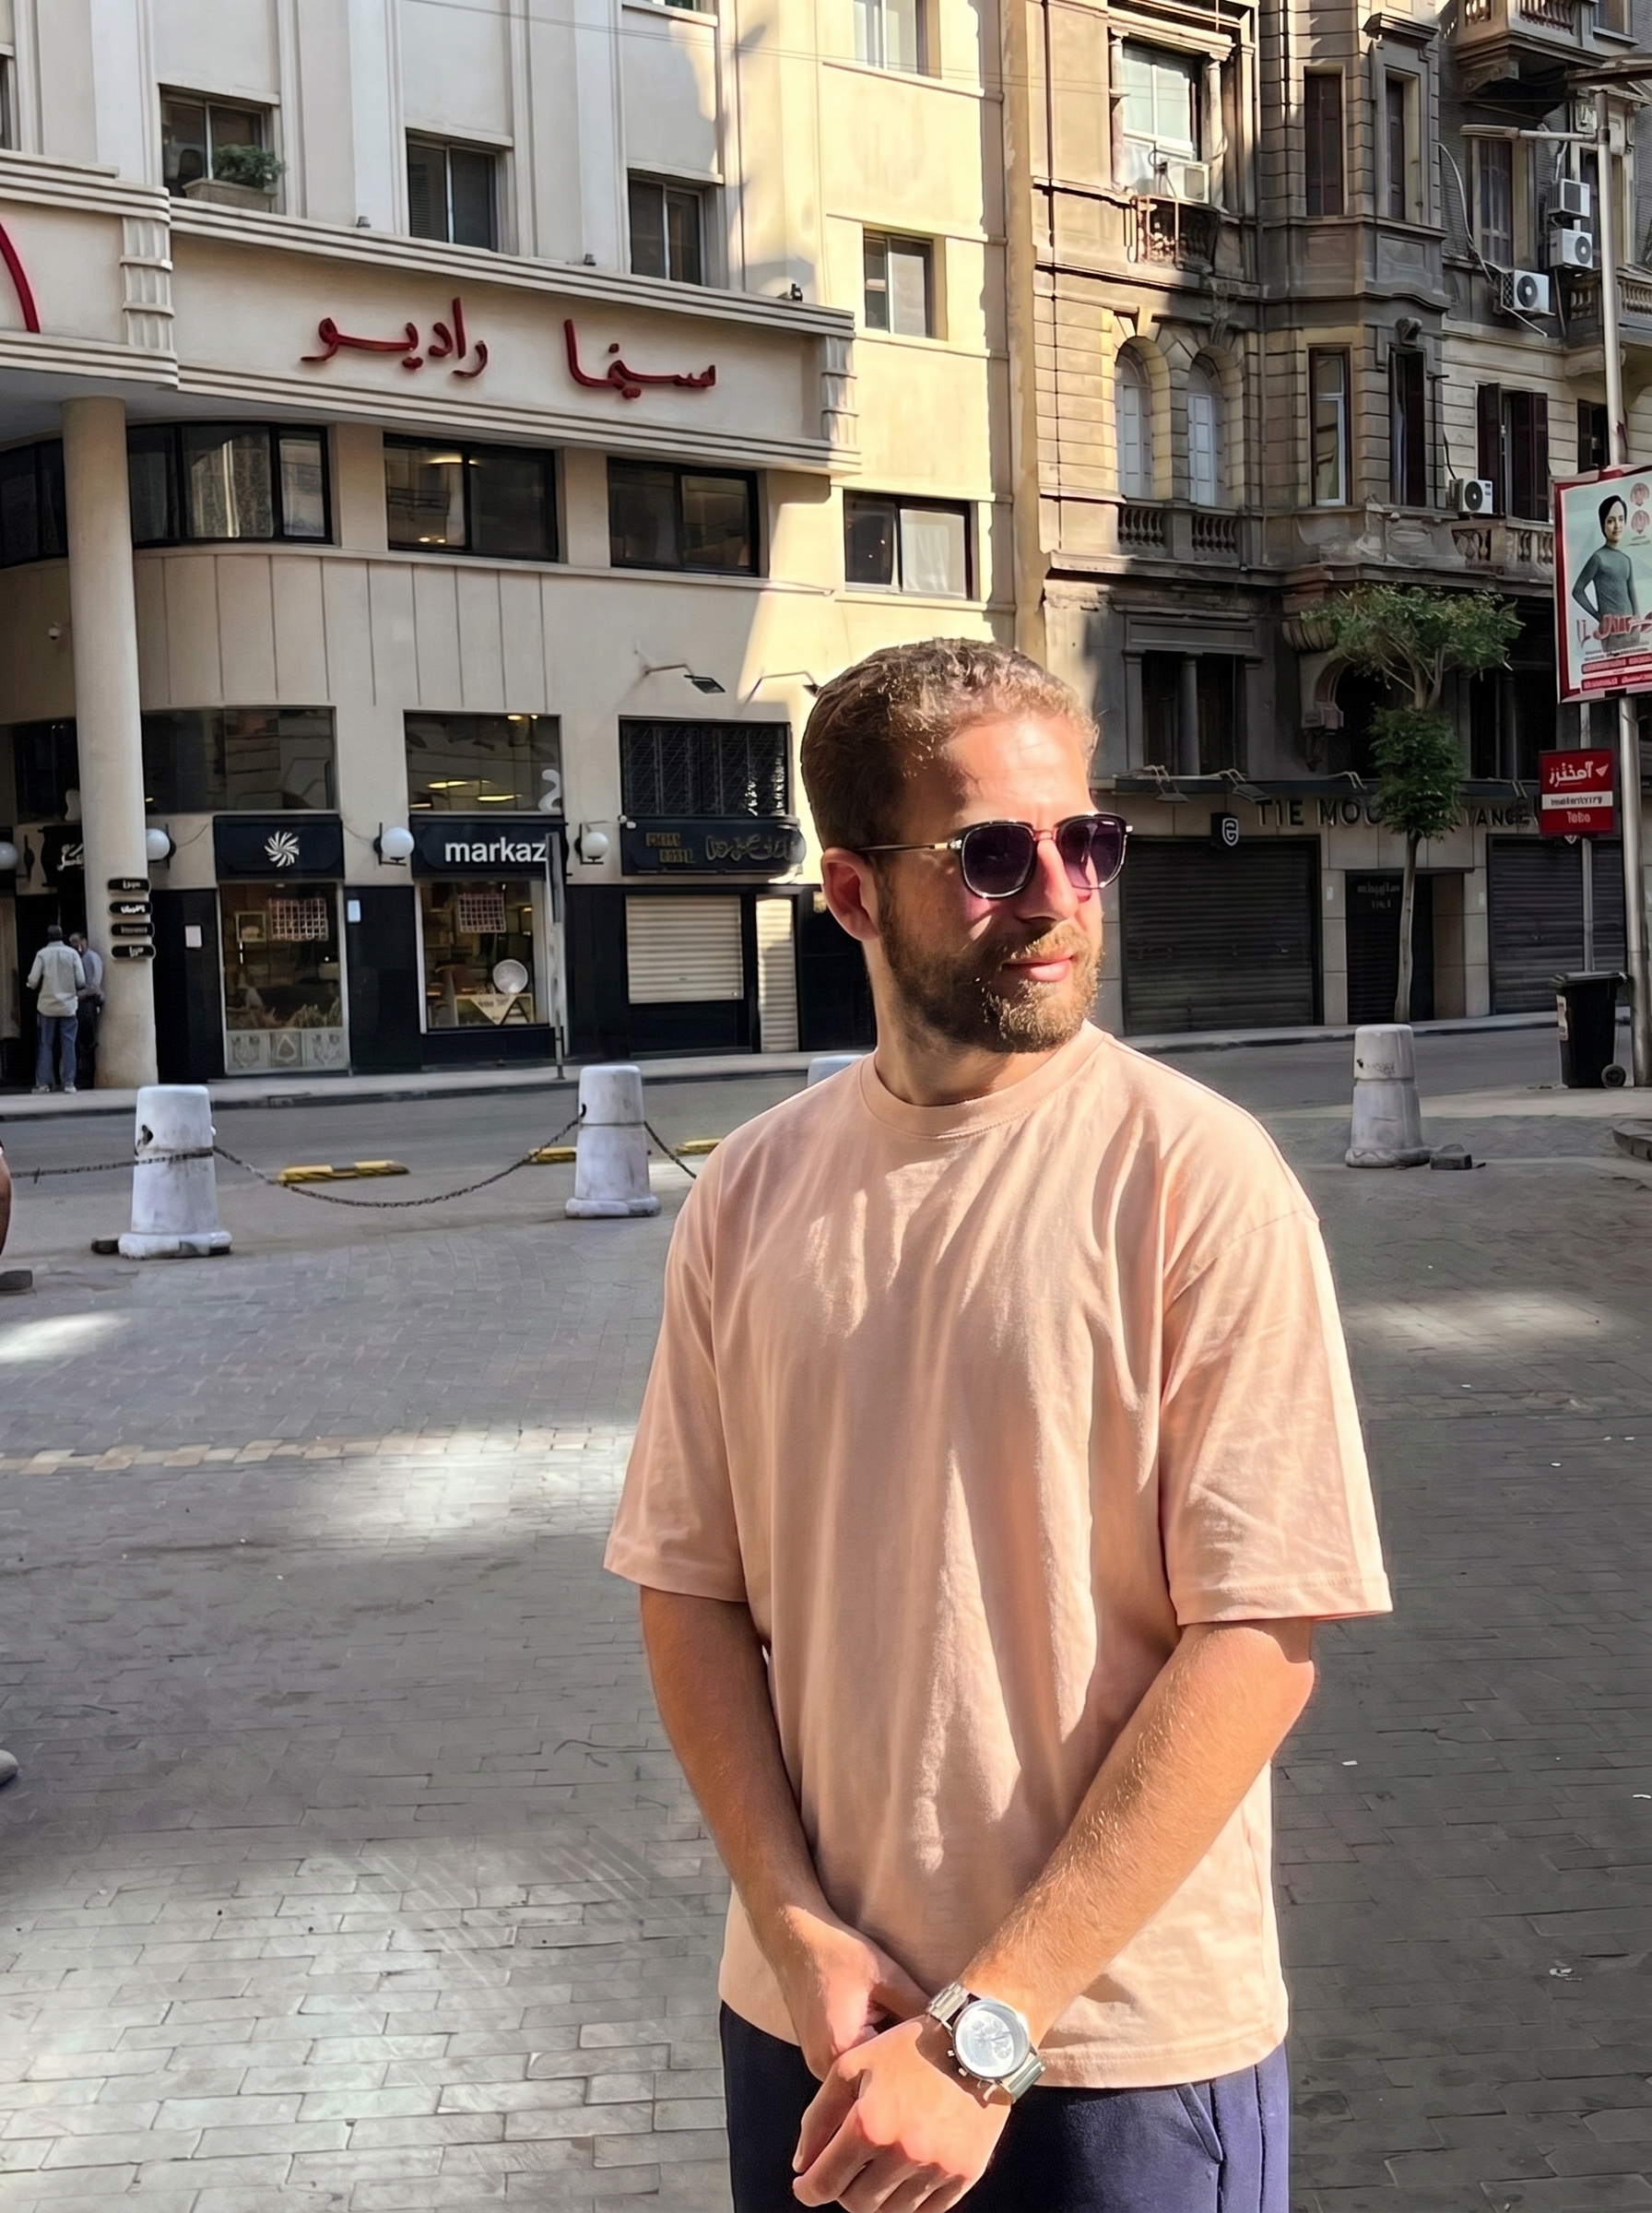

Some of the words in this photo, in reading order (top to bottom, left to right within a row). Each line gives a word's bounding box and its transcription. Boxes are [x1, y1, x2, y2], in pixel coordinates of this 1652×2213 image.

[300, 296, 489, 378] راديو
[563, 318, 716, 399] سينما
[444, 835, 549, 863] markaz
